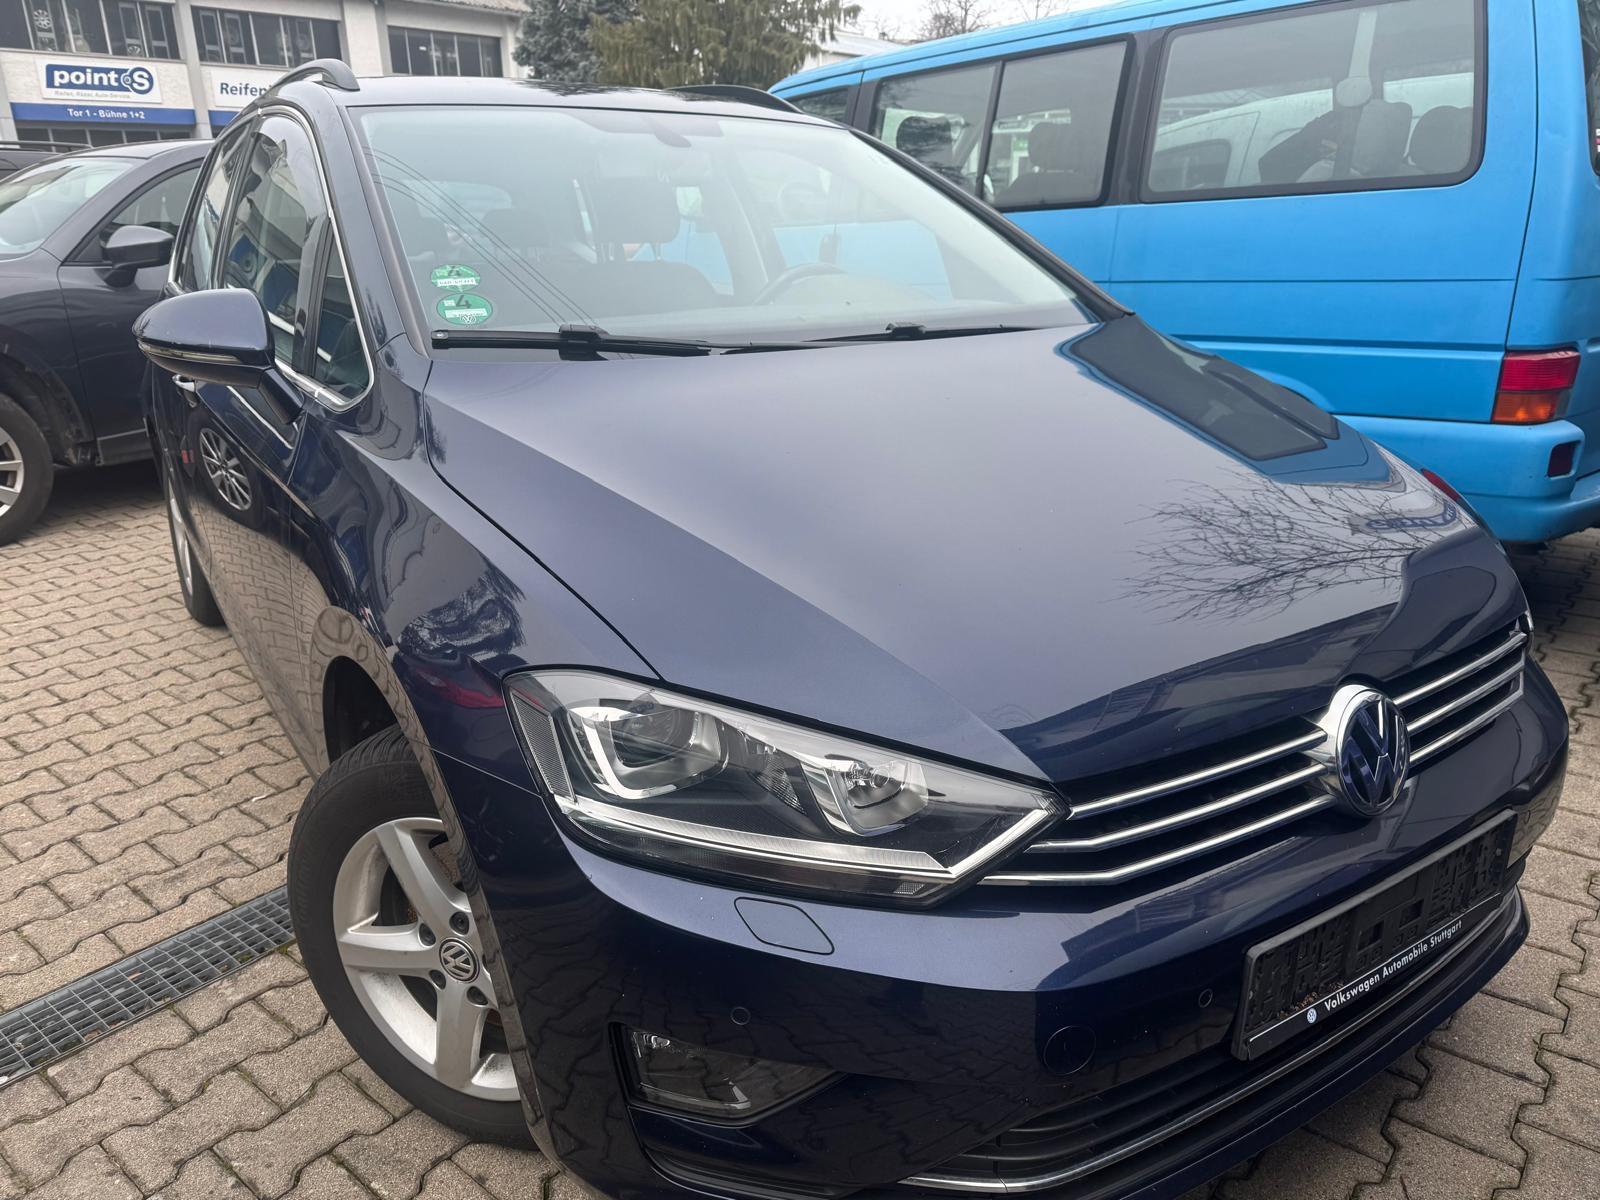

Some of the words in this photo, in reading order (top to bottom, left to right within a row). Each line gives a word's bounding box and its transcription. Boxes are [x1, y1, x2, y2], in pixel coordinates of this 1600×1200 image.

[53, 68, 119, 87] point
[132, 70, 150, 91] S
[220, 82, 272, 97] Reifen
[67, 108, 83, 118] Tor
[85, 109, 91, 118] 1
[99, 109, 128, 119] Bühne
[129, 111, 146, 120] 1+2
[455, 294, 472, 309] 4
[1323, 973, 1380, 1012] Volkswagen
[1382, 942, 1428, 979] Automobile
[1429, 919, 1463, 948] Stuttgart
